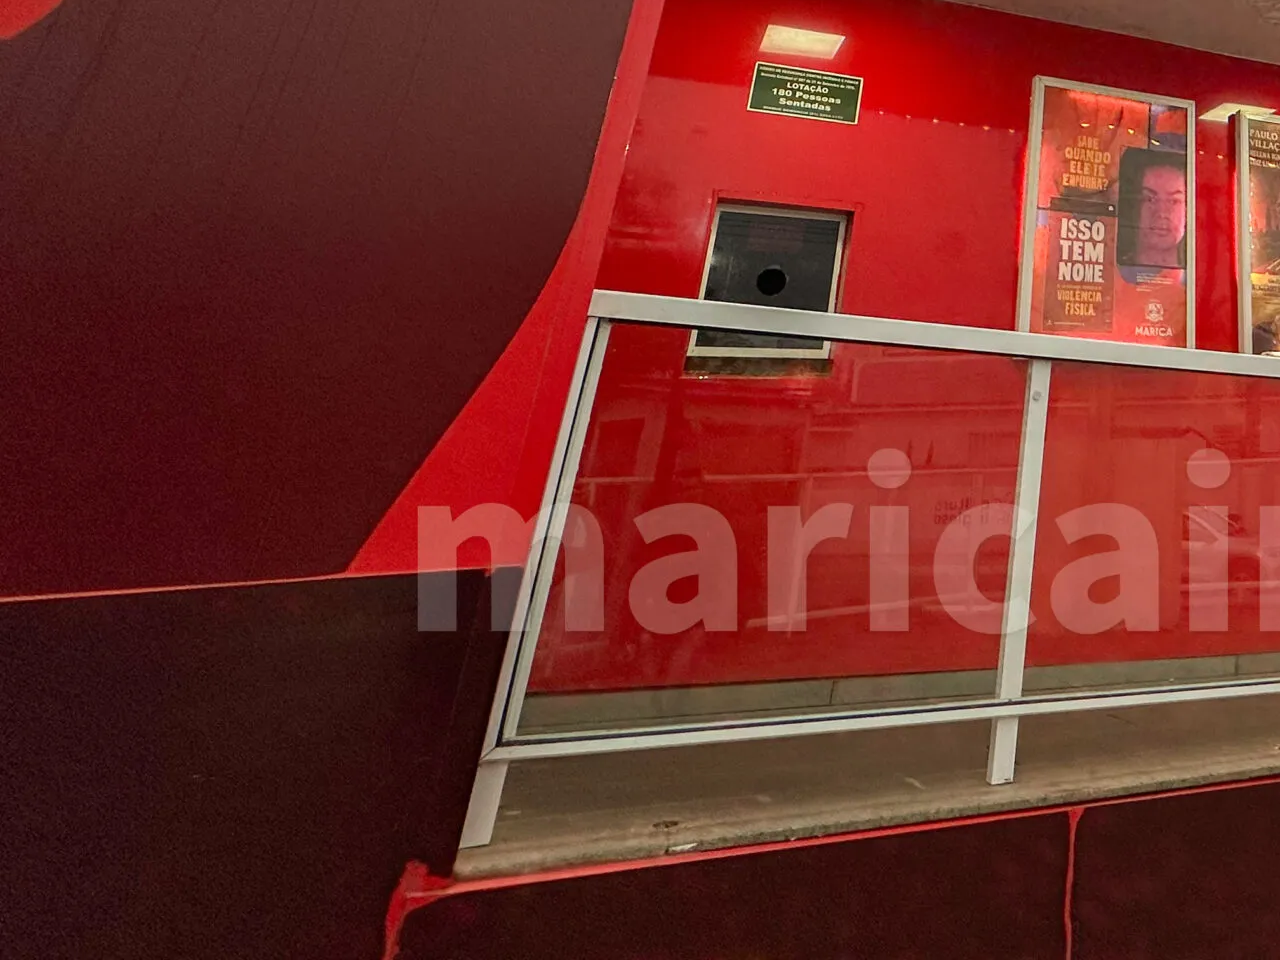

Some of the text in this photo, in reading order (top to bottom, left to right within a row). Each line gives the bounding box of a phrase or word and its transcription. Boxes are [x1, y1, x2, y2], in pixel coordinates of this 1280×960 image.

[787, 82, 829, 94] LOTAÇÃO
[772, 88, 841, 104] 180 Pessoas
[779, 97, 831, 112] Sentadas
[1250, 129, 1279, 141] PAULO
[1064, 147, 1111, 164] QUANDO
[1069, 160, 1091, 175] ELE
[1061, 218, 1105, 241] ISSO
[1060, 240, 1105, 263] TEM
